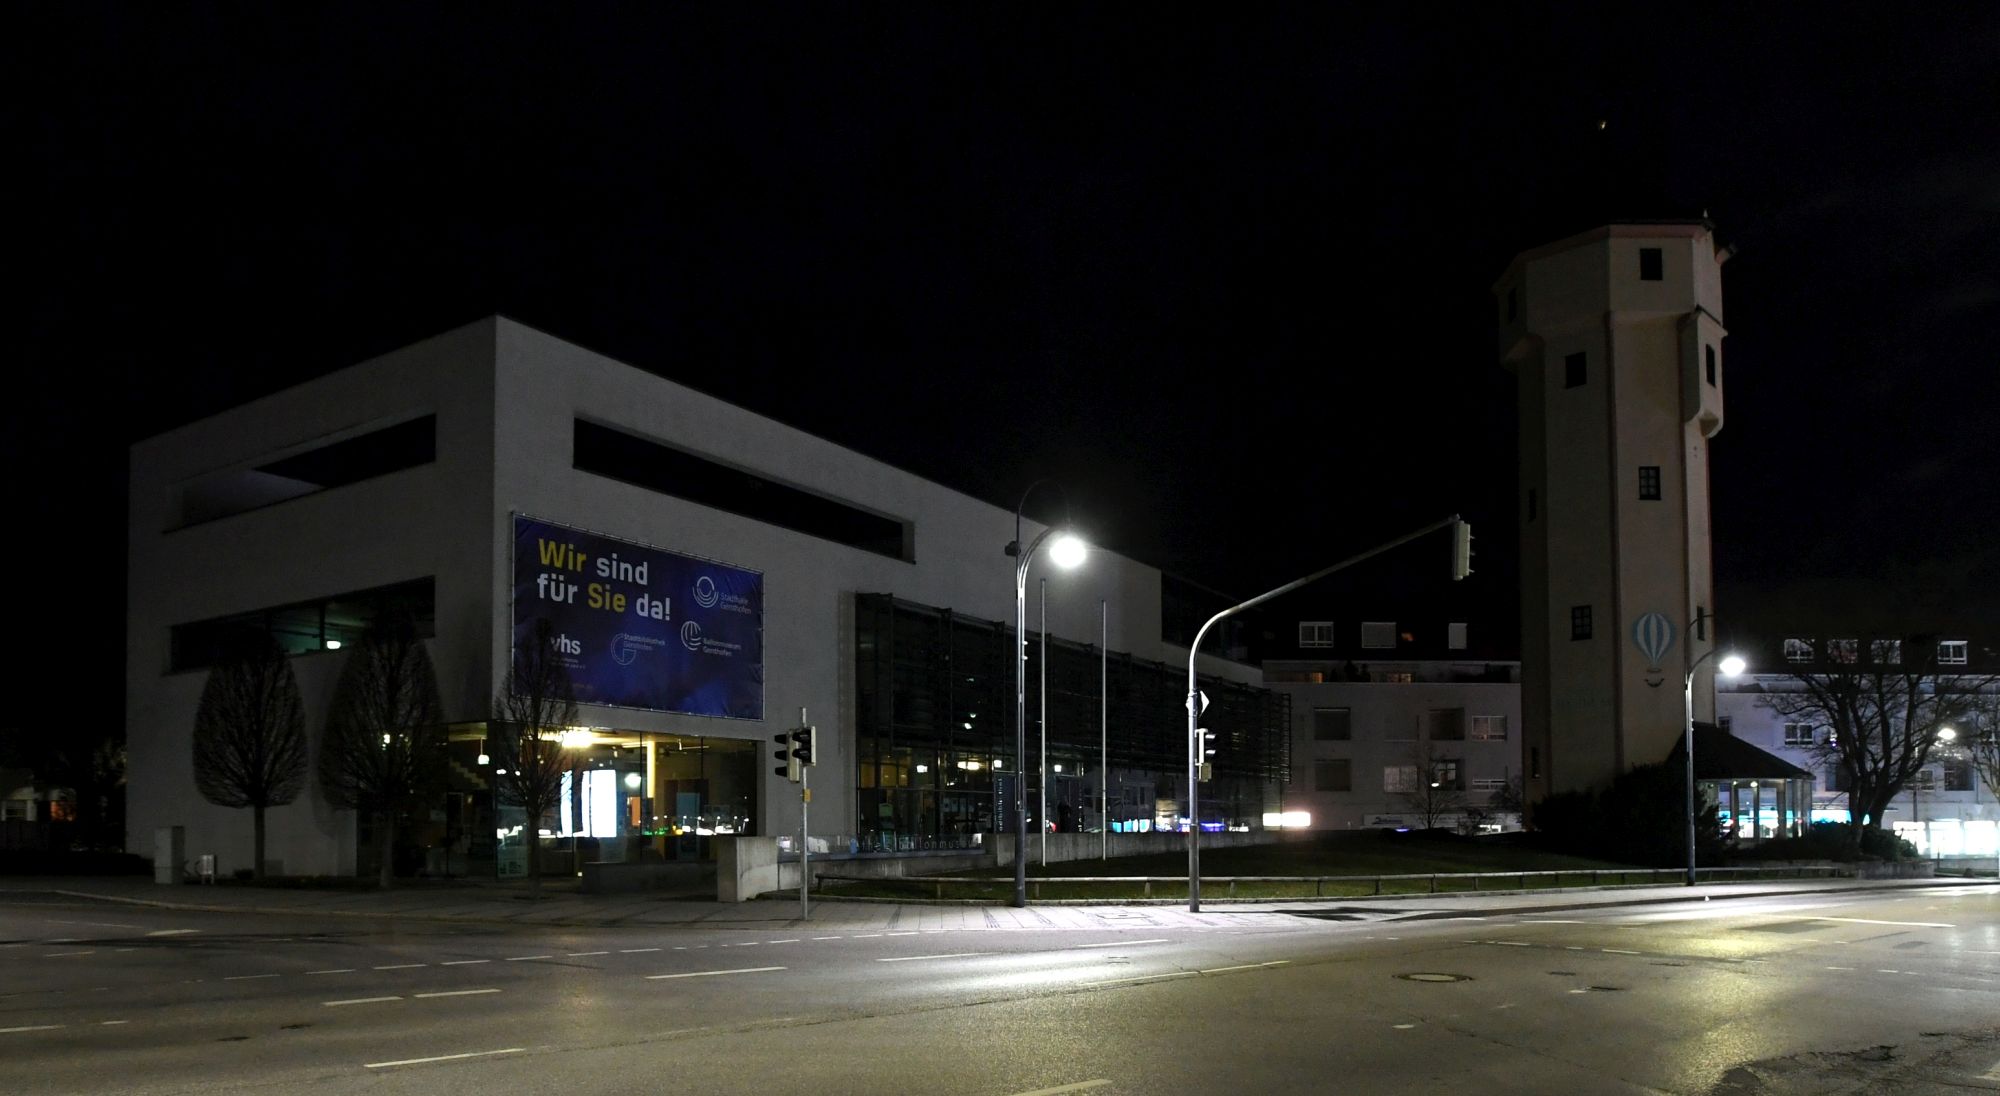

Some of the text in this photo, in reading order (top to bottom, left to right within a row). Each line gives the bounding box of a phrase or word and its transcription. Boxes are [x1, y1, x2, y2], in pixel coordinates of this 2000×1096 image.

[538, 538, 648, 586] Wir sind
[537, 573, 671, 621] für Sie da!
[550, 633, 581, 655] vhs
